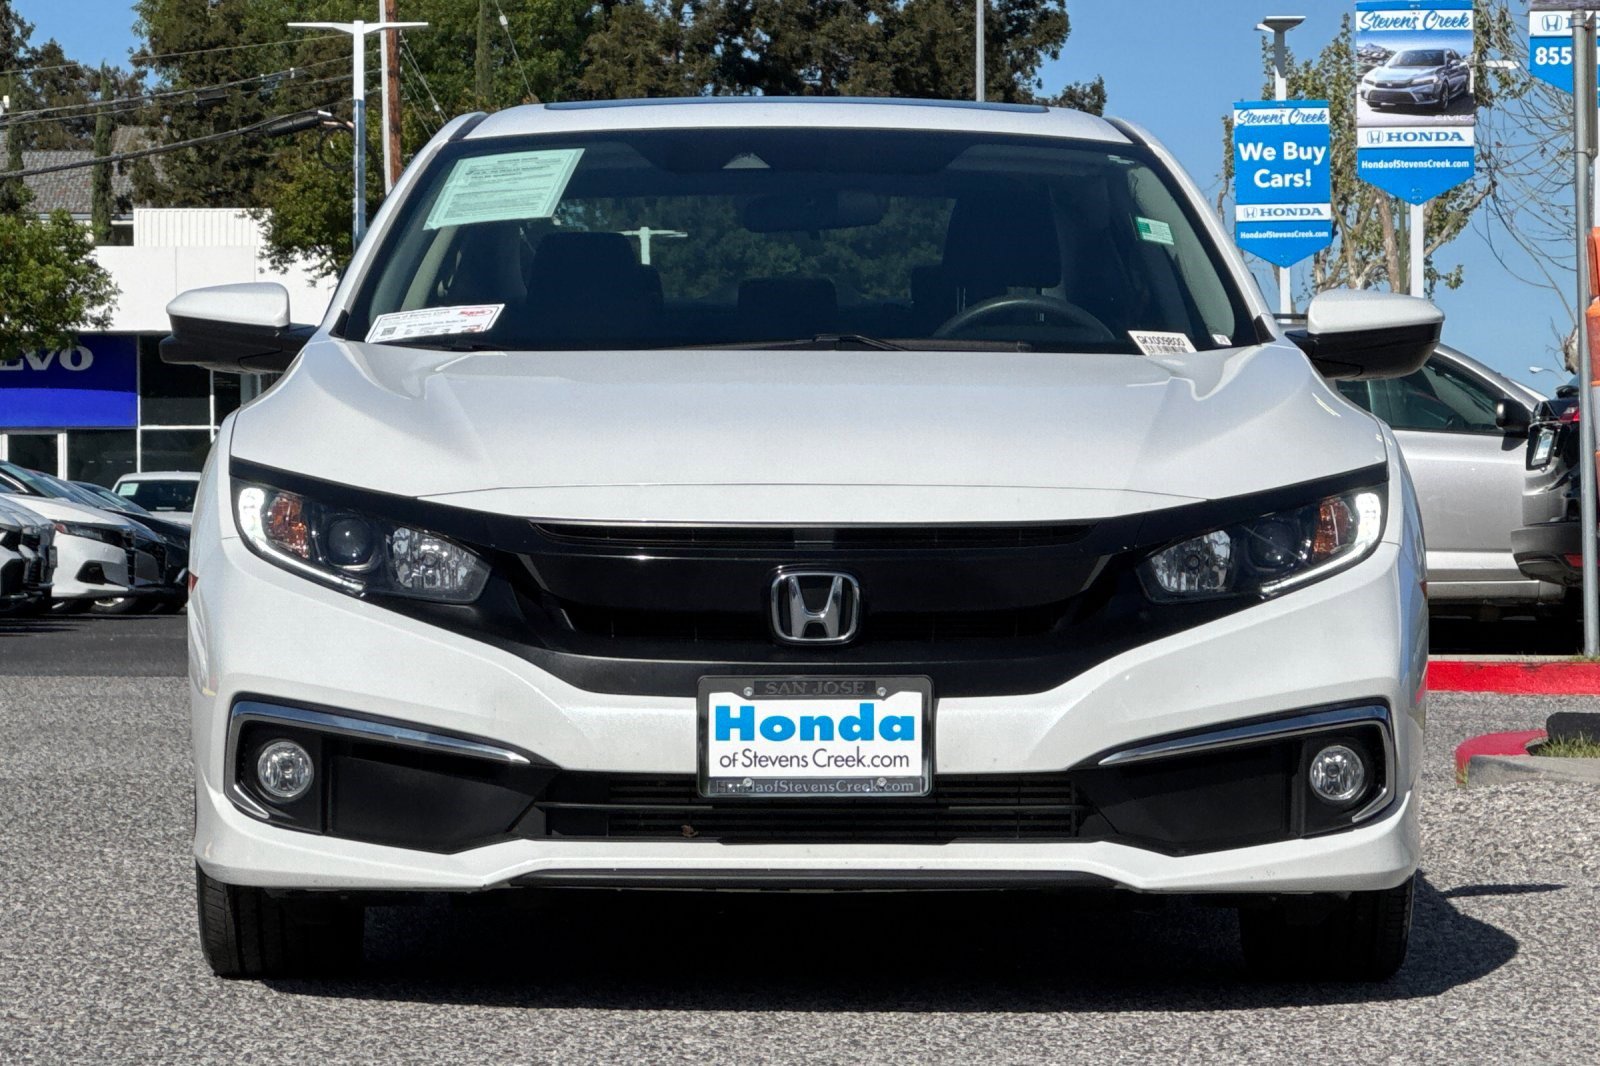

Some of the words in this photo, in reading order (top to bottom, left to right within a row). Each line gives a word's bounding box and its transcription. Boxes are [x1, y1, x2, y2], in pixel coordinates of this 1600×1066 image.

[1359, 11, 1417, 31] Stevens
[1422, 11, 1470, 31] Creek
[1535, 46, 1572, 65] 855
[1236, 109, 1285, 126] Stevens
[1288, 108, 1328, 125] Creek
[1386, 131, 1464, 142] HONDA
[1238, 142, 1276, 161] We
[1283, 141, 1327, 165] Buy
[1361, 159, 1470, 169] HondaofStevensCreek.com
[1253, 169, 1312, 188] Cars!
[1259, 207, 1324, 218] HONDA
[1240, 230, 1329, 239] HondaofStevensCreek.com
[765, 681, 808, 696] SAN
[812, 681, 866, 696] JOSE
[715, 703, 915, 742] Honda
[719, 751, 738, 768] of
[741, 748, 809, 768] Stevens
[812, 746, 910, 768] Creek.com
[715, 779, 914, 793] HdaofStevensCreek.com
